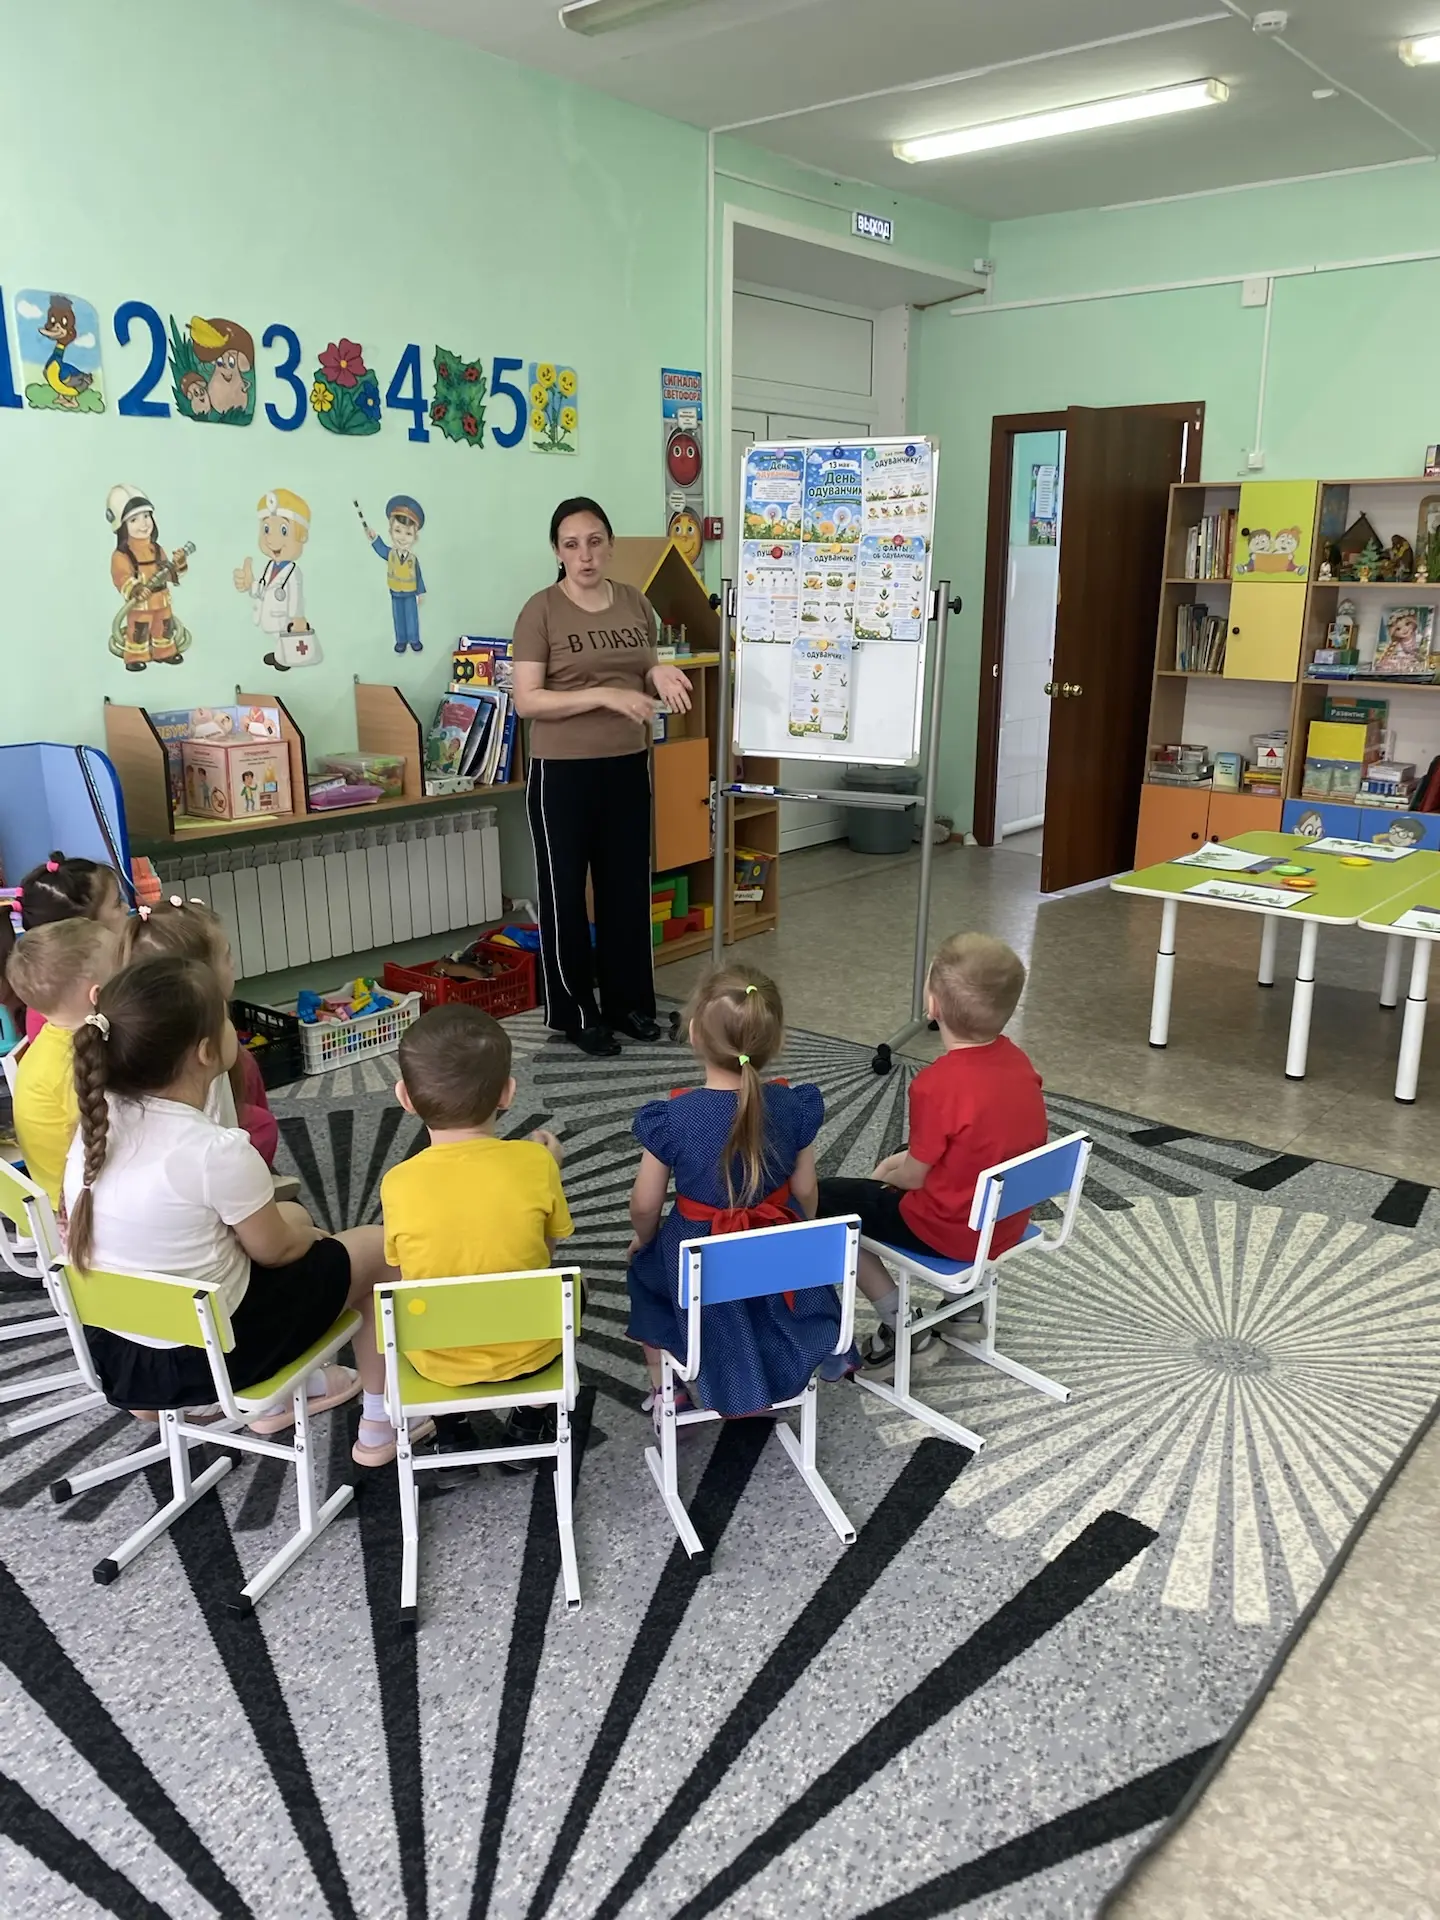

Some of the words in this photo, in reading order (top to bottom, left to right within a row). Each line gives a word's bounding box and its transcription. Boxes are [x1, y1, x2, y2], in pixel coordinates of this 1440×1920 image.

[857, 214, 890, 239] ВЫХОД
[113, 301, 171, 418] 2
[262, 323, 308, 431] 3
[386, 343, 430, 443] 4
[490, 357, 528, 448] 5
[663, 388, 702, 402] СВЕТОФОРА
[769, 461, 791, 471] День
[829, 461, 837, 469] 13
[825, 472, 856, 486] День
[568, 634, 583, 653] В
